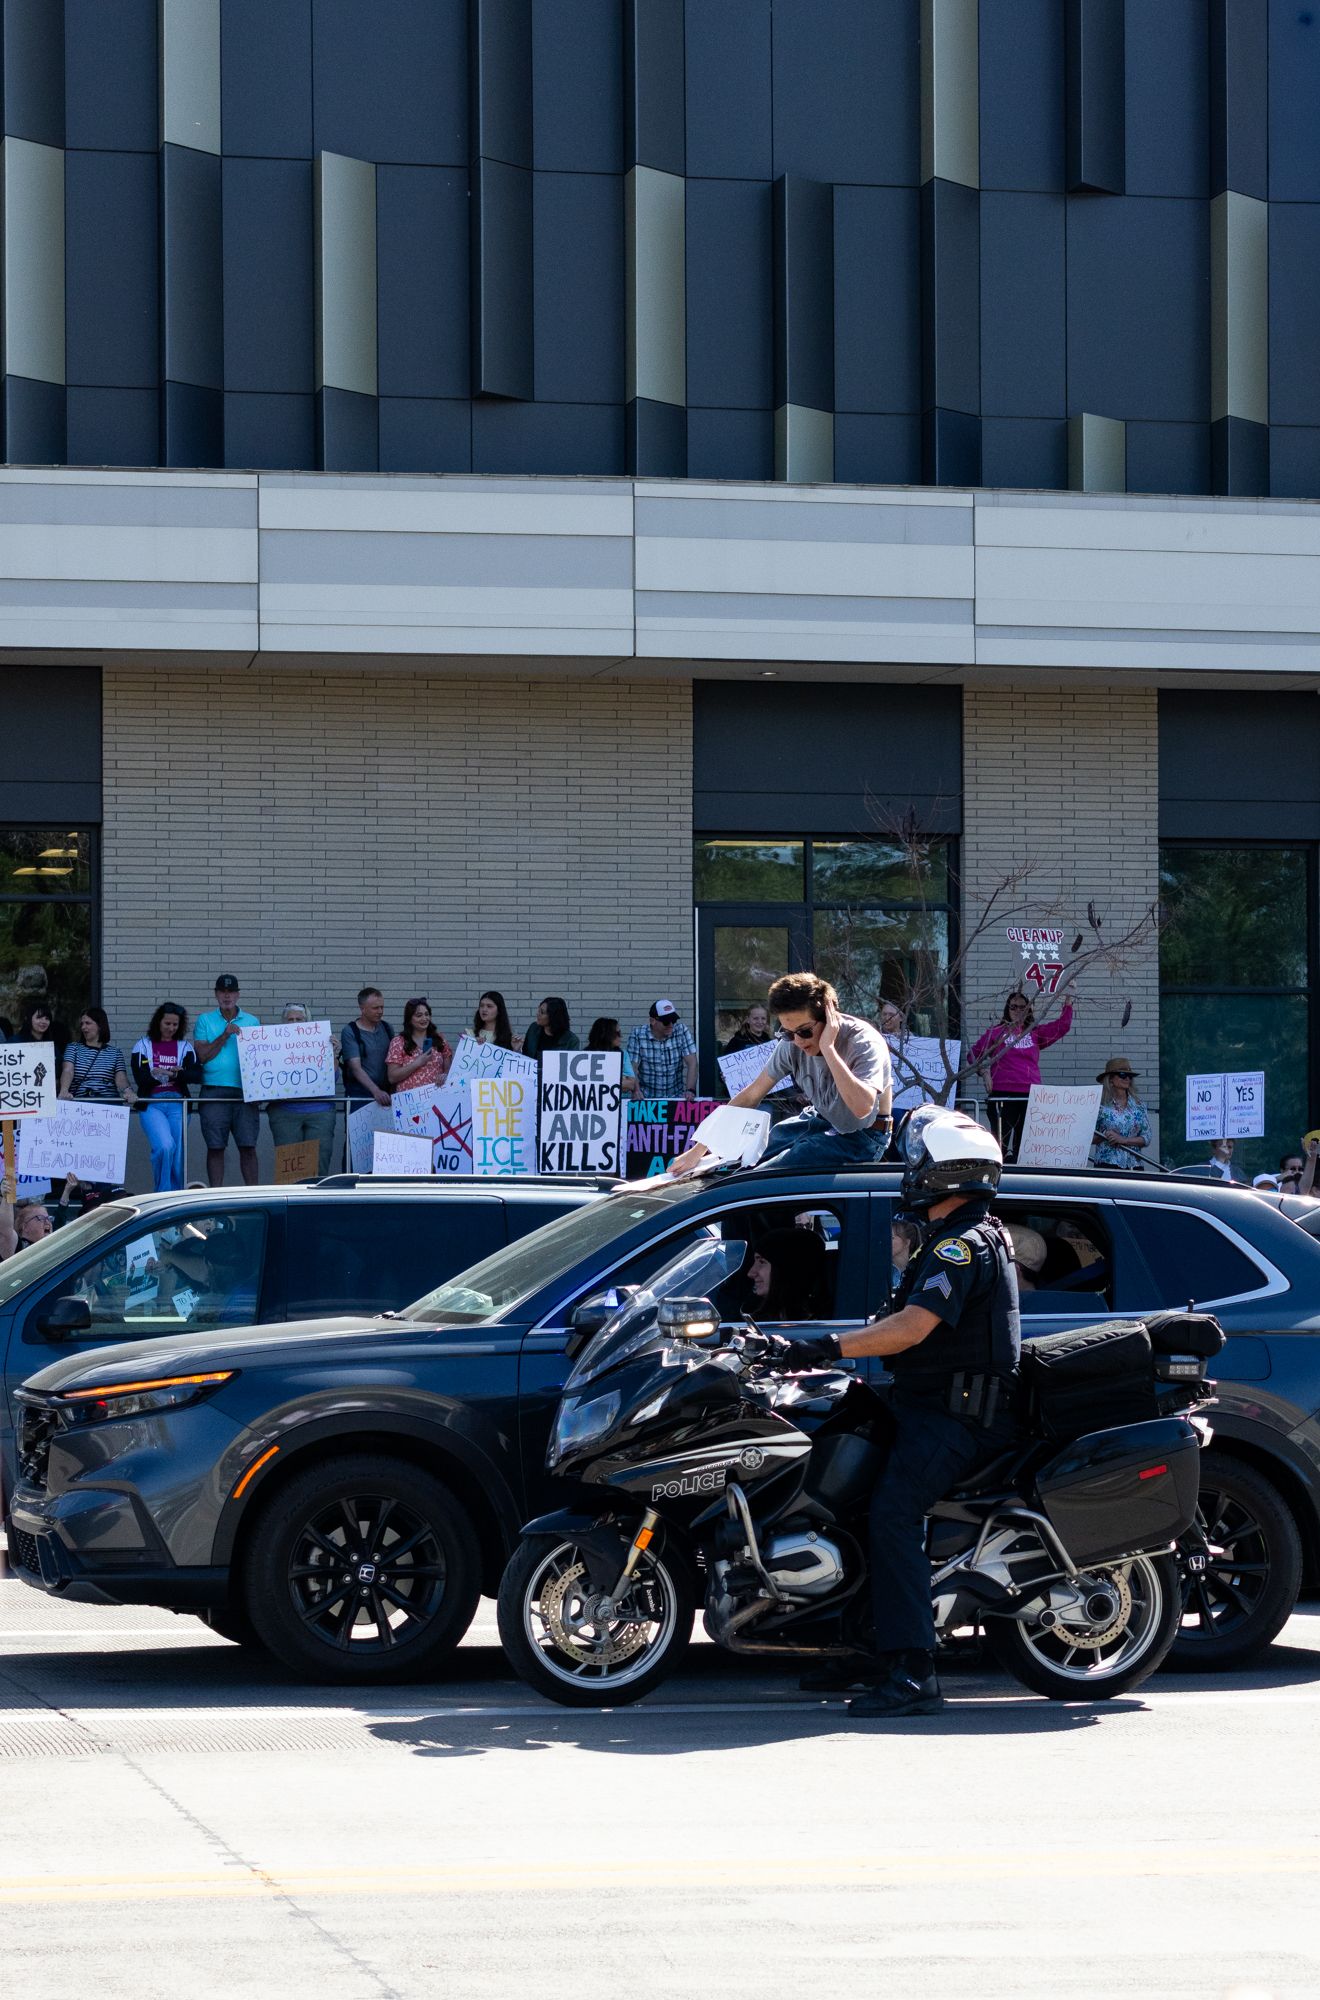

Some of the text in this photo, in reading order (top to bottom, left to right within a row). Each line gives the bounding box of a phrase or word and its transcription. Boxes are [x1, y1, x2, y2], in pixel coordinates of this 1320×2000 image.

[1007, 927, 1064, 945] CLEANUP
[1022, 943, 1034, 951] on
[1025, 963, 1065, 994] 47
[274, 1027, 290, 1038] us
[247, 1042, 281, 1061] grow
[463, 1037, 478, 1055] IT
[284, 1052, 324, 1068] doing
[459, 1055, 493, 1079] SAY
[559, 1052, 606, 1082] ICE
[260, 1068, 318, 1089] GOOD
[478, 1080, 524, 1108] END
[542, 1083, 621, 1112] KIDNAPS
[1197, 1090, 1212, 1103] NO
[1235, 1086, 1255, 1102] YES
[627, 1100, 669, 1123] MAKE
[47, 1118, 111, 1137] WOMEN
[477, 1107, 523, 1137] THE
[547, 1112, 607, 1142] AND
[1237, 1126, 1250, 1134] USA
[477, 1136, 525, 1168] ICE
[541, 1141, 617, 1172] KILLS
[281, 1155, 306, 1173] ICE
[437, 1154, 460, 1171] NO
[652, 1469, 726, 1502] POLICE
